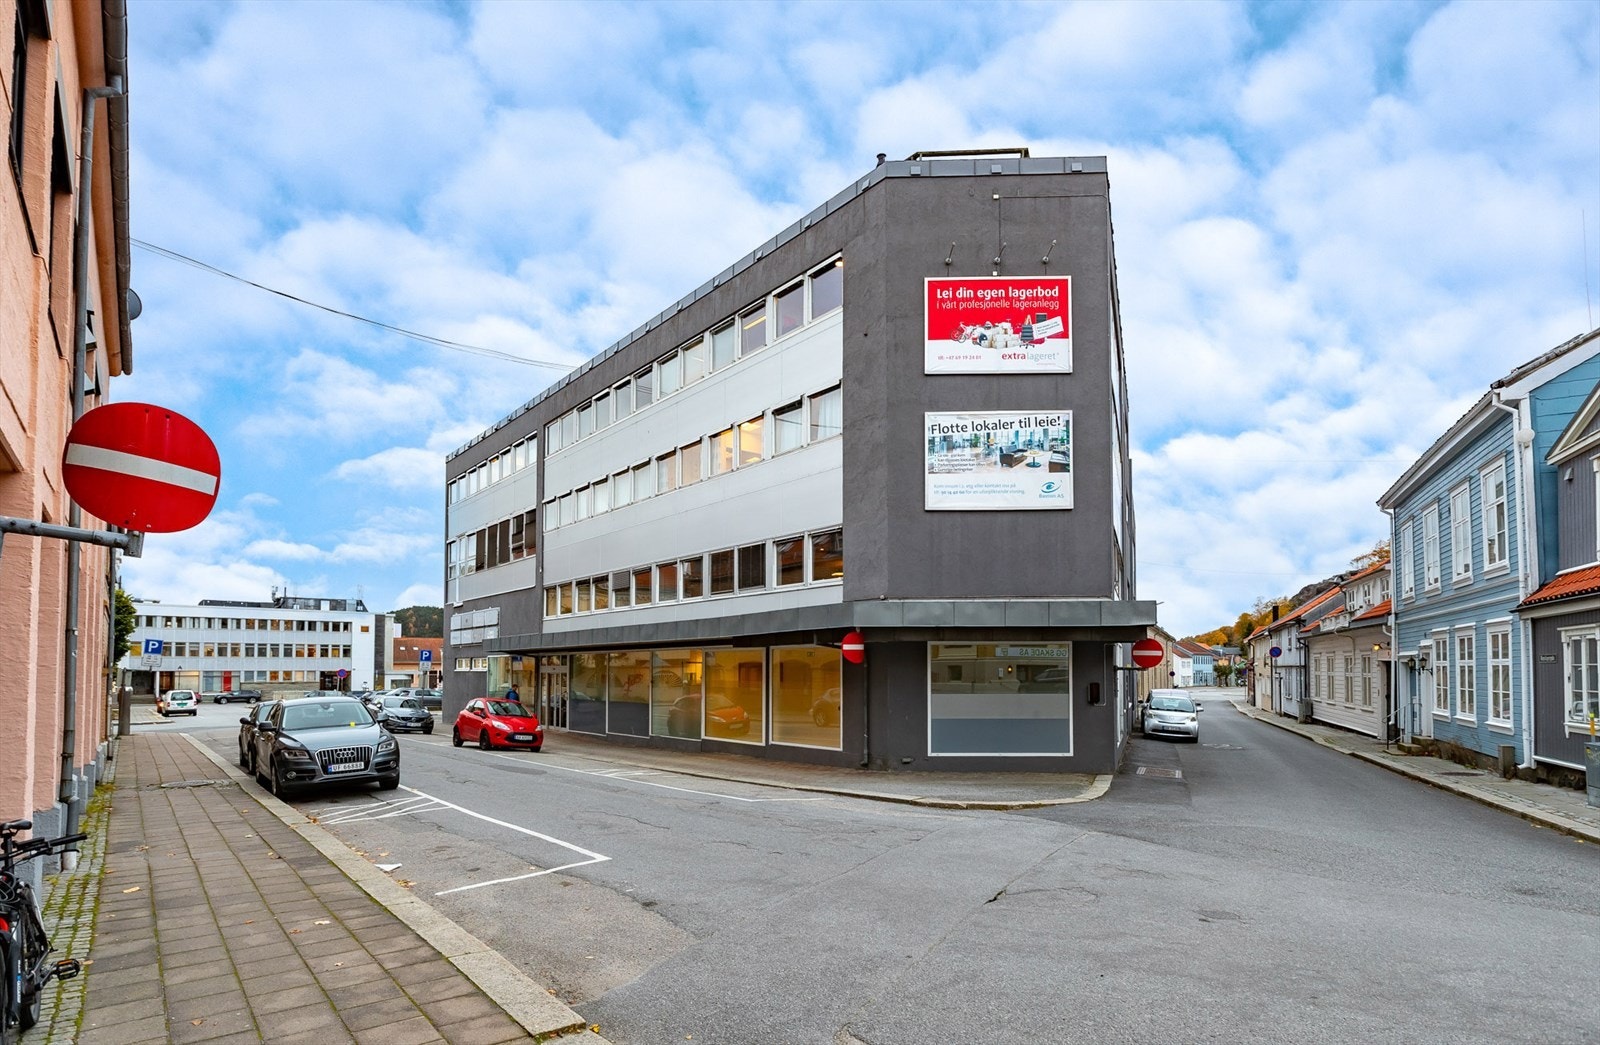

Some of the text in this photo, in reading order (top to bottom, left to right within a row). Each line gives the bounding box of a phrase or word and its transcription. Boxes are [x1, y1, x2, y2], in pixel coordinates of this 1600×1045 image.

[937, 286, 1059, 300] Lei din egen lagerbod
[942, 300, 957, 309] vårt
[960, 300, 1010, 310] profesjonelle
[1012, 299, 1060, 310] lageranlegg
[931, 416, 1061, 435] Flotte lokaler til leie!
[148, 641, 159, 652] P
[422, 651, 429, 660] P
